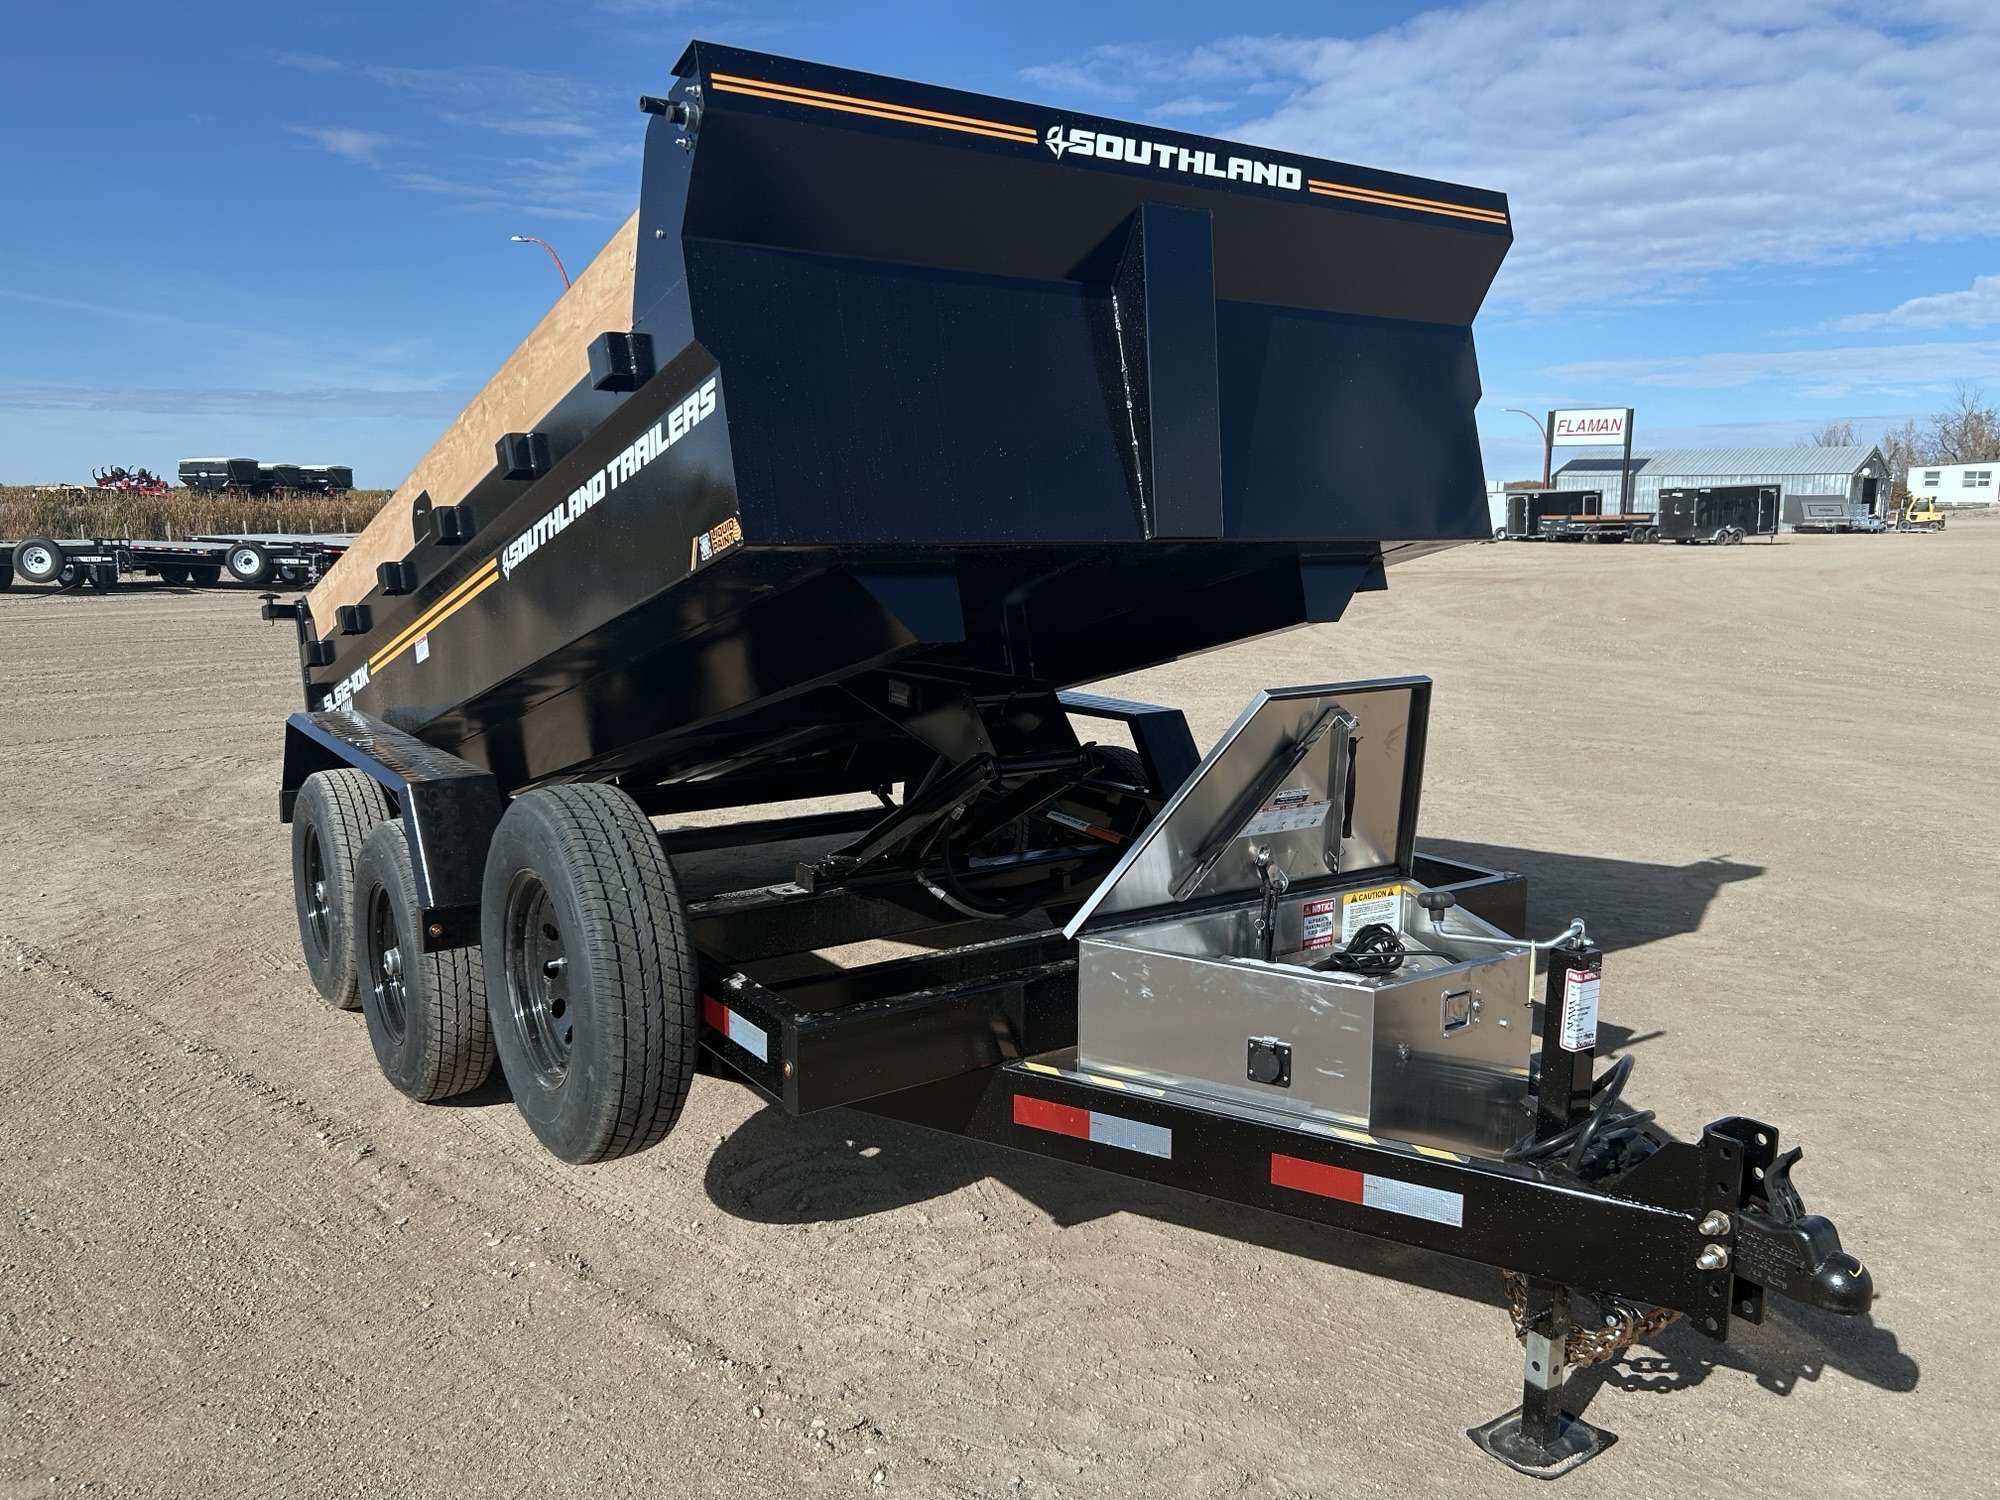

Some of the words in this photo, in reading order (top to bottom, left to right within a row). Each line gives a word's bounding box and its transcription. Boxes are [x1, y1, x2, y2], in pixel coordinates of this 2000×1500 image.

[1068, 128, 1302, 191] SOUTHLAND
[1556, 418, 1622, 433] FLAMAN
[509, 469, 606, 569] SOUTHLAND
[607, 377, 716, 490] TRAILERS
[712, 520, 734, 540] LIQUID
[713, 531, 735, 550] PAINT
[1359, 890, 1387, 902] CAUTION
[1312, 902, 1333, 913] NOTICE
